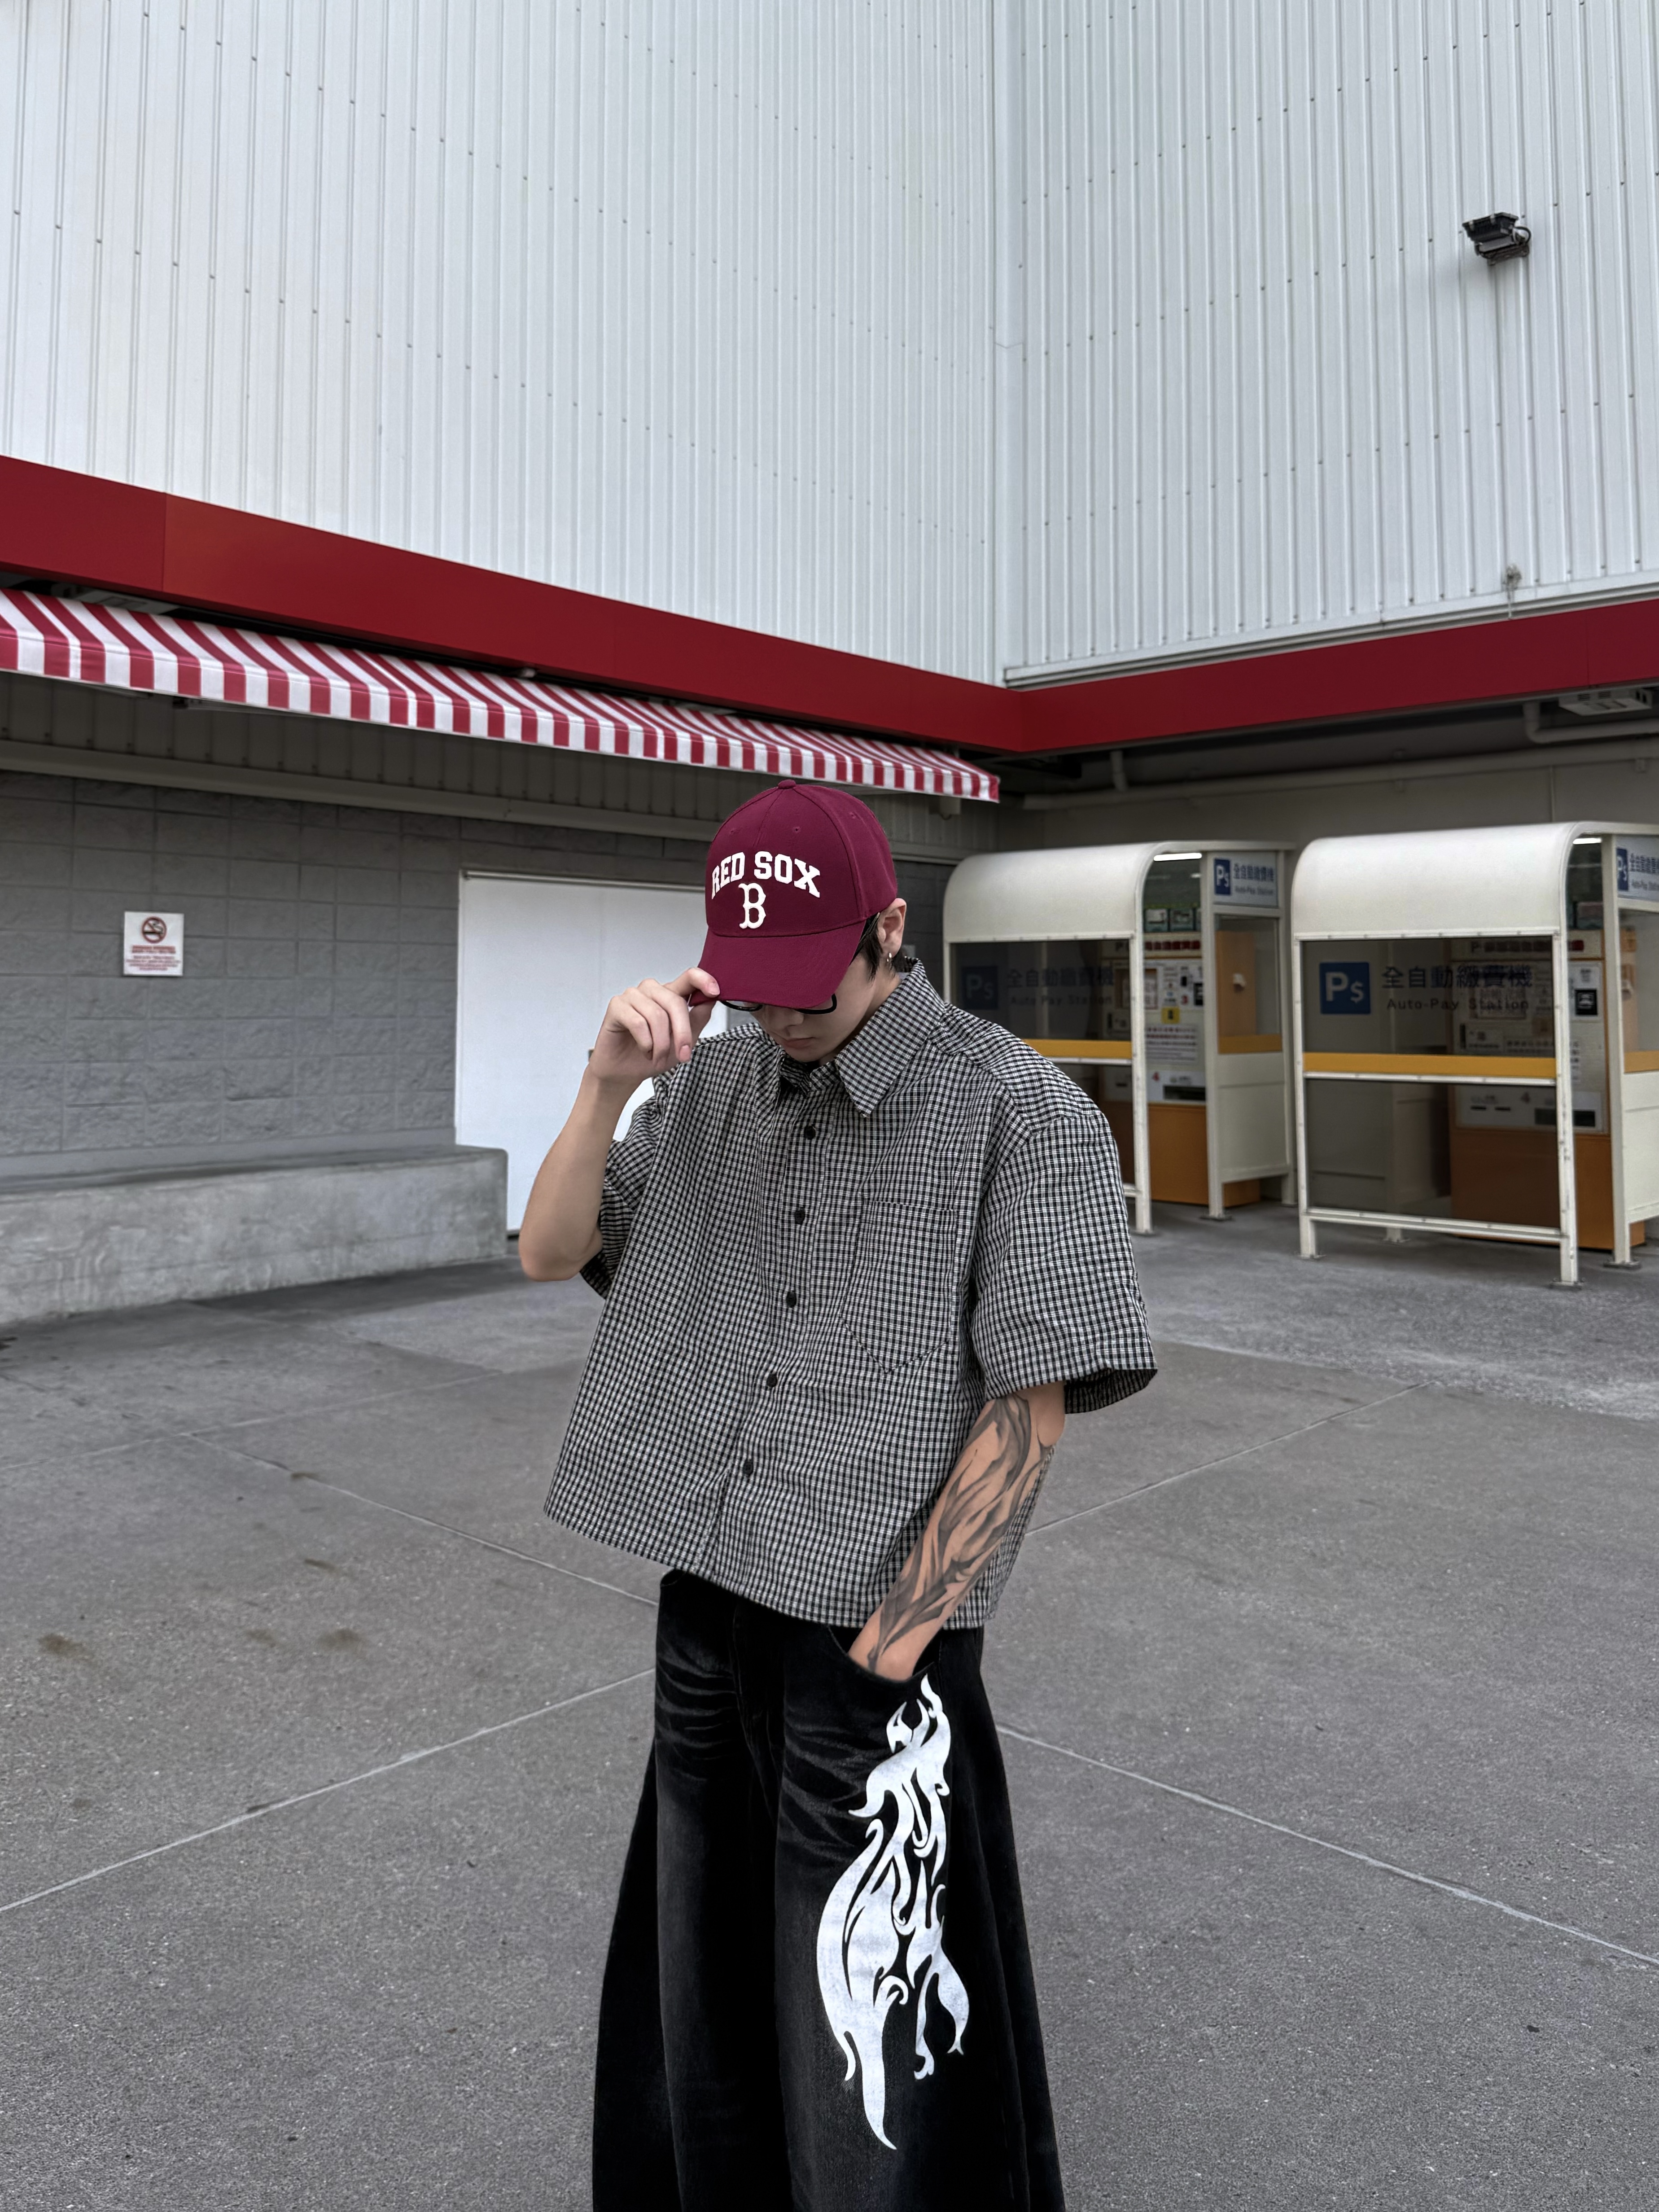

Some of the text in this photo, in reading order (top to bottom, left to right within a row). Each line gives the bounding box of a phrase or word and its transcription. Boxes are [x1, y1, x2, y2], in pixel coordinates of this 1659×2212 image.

[711, 851, 820, 899] RED SOX
[738, 882, 766, 929] B
[1387, 998, 1529, 1012] Auto-Pay Station
